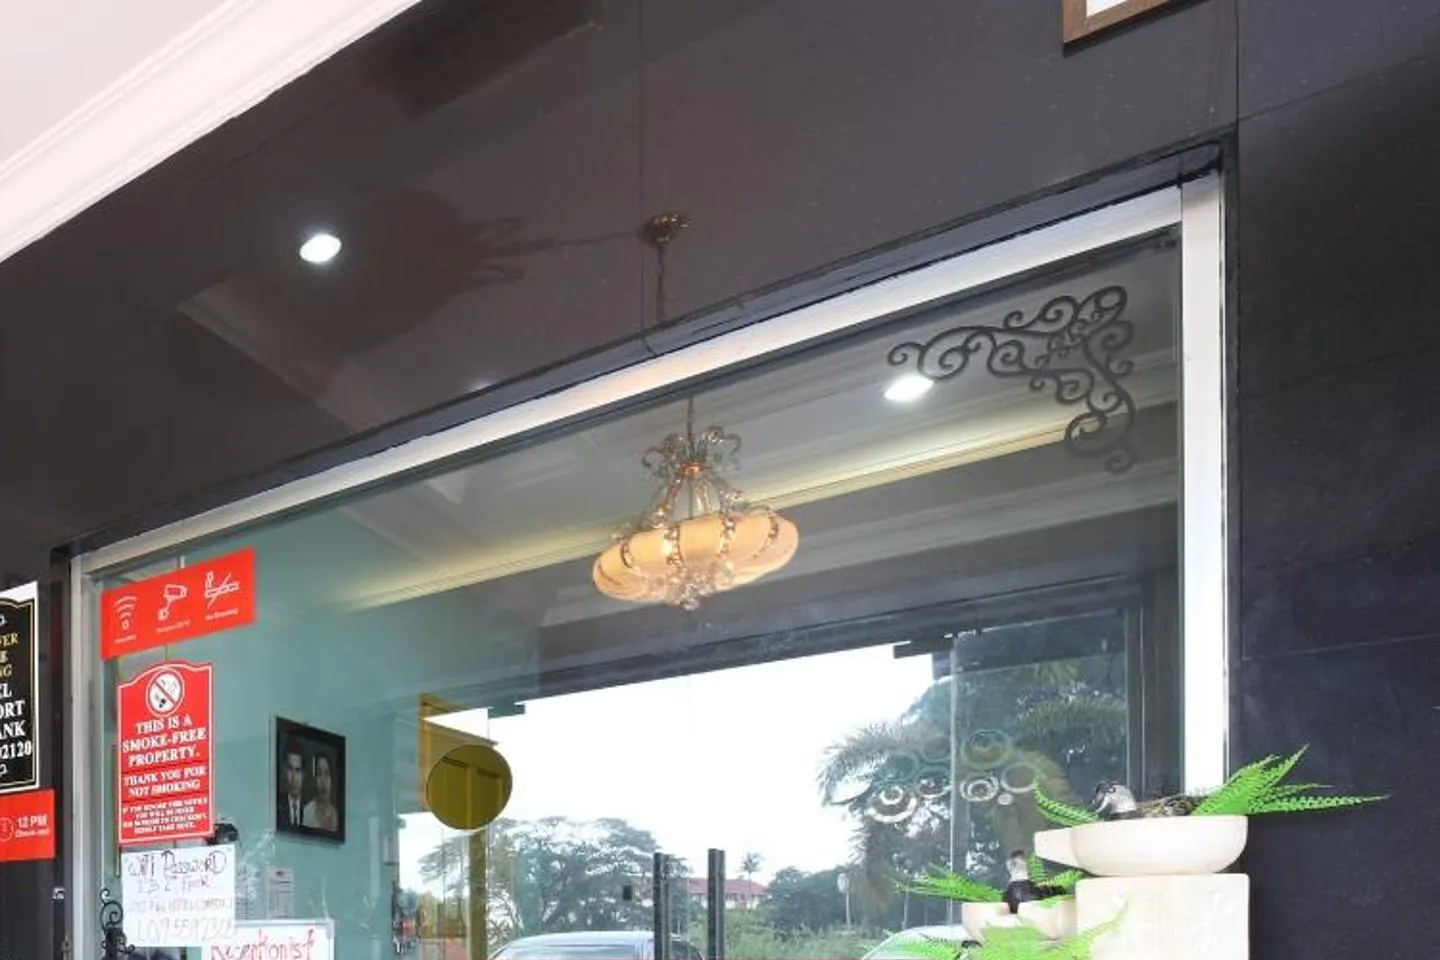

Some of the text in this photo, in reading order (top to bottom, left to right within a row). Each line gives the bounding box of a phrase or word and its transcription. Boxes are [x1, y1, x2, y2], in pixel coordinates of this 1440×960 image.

[135, 713, 192, 734] THIS IS A
[122, 727, 206, 753] SMOKE-FREE
[128, 744, 200, 767] PROPERTY.
[124, 766, 206, 786] THANK YOU FOR
[129, 780, 201, 797] NOT SMOKING
[18, 814, 47, 828] 12 PM
